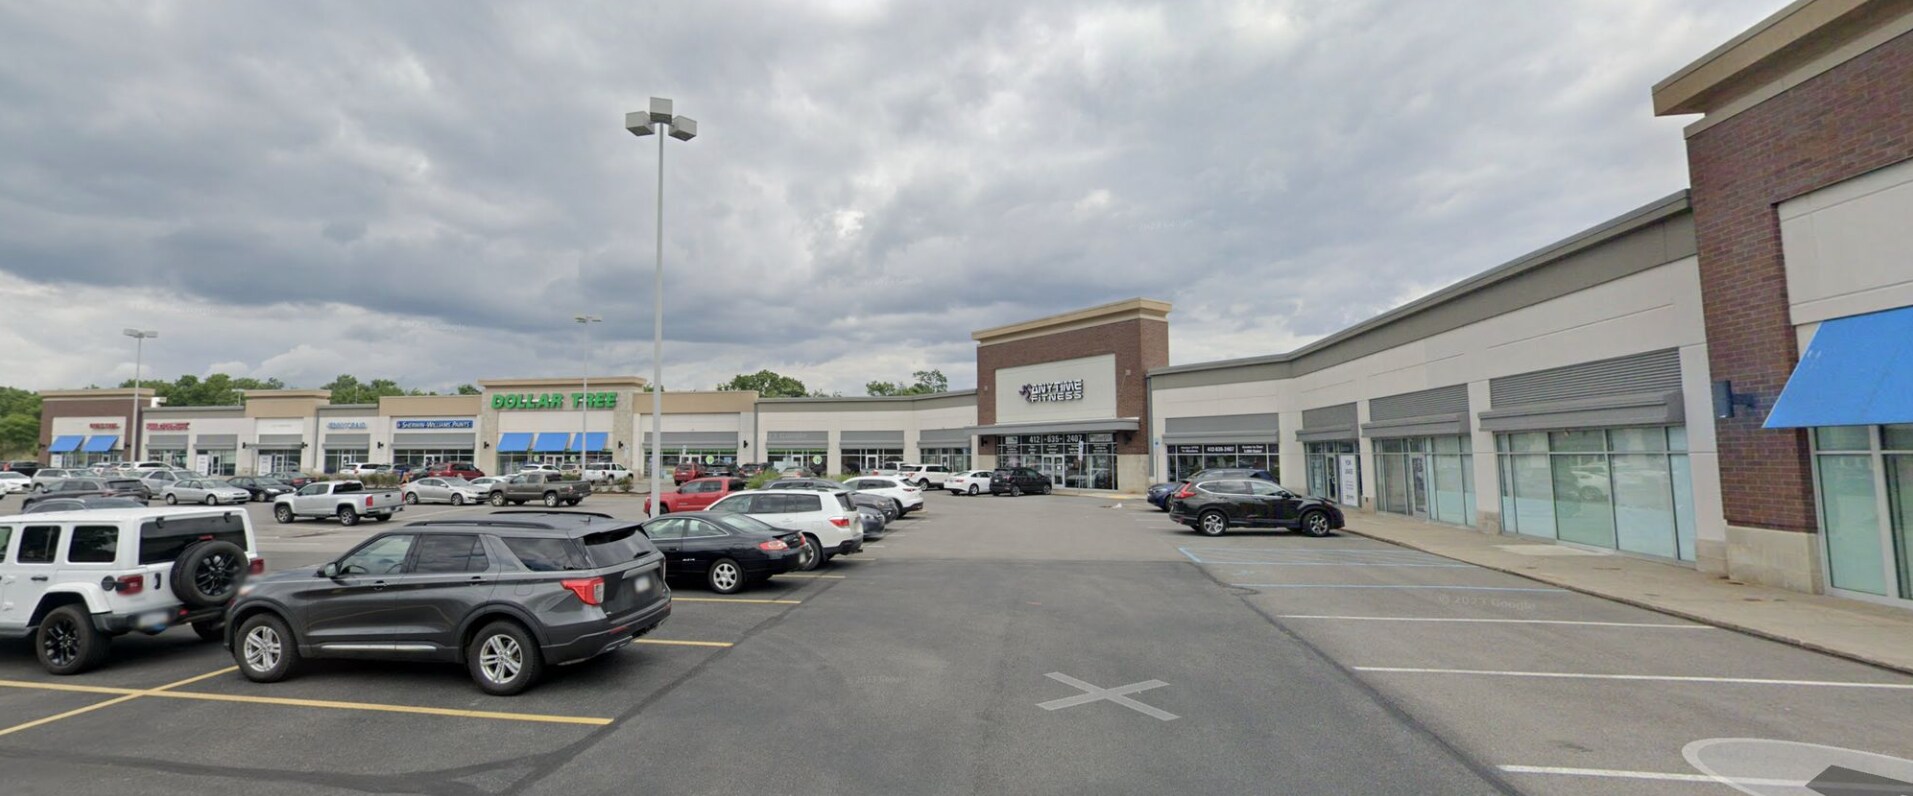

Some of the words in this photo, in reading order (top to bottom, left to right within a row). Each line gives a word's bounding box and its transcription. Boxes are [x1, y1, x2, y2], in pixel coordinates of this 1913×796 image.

[1031, 379, 1083, 394] ANYTIME
[491, 393, 564, 410] DOLLAR
[571, 392, 617, 409] TREE
[1031, 390, 1083, 402] FITNESS
[1029, 435, 1041, 443] 412
